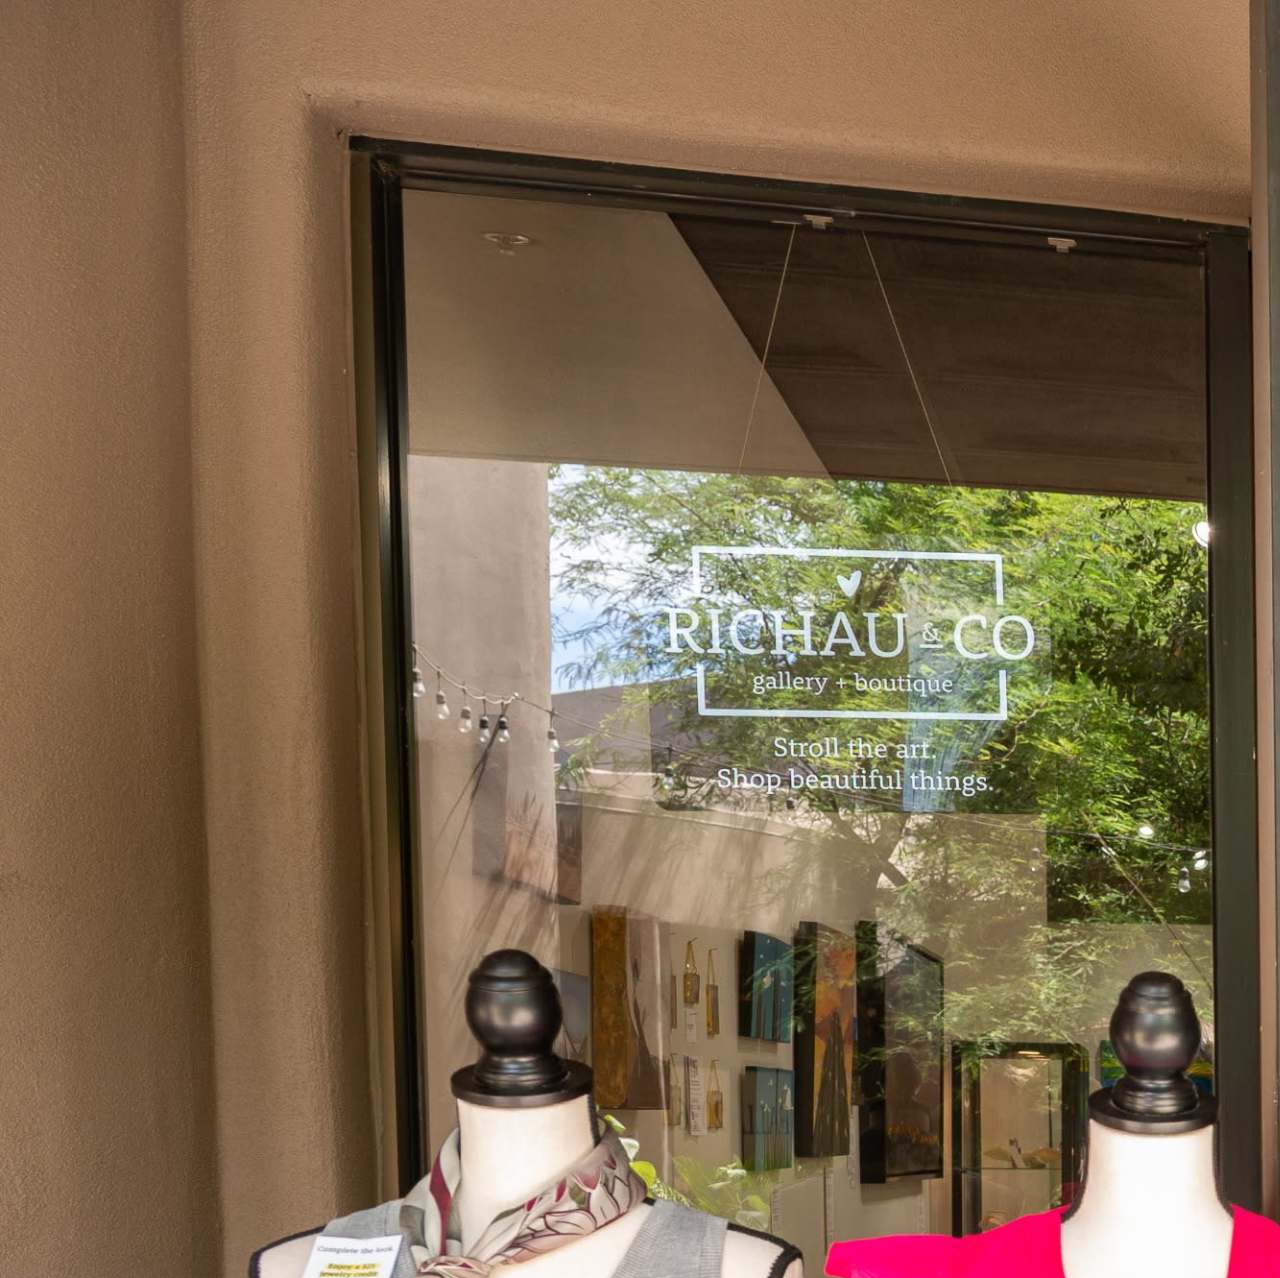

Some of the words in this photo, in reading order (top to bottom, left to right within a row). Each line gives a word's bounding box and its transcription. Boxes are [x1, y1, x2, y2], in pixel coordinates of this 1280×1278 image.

[664, 606, 908, 658] RICHAU
[919, 622, 943, 648] &
[953, 613, 1035, 661] CO
[752, 672, 828, 695] gallery
[836, 678, 846, 688] +
[854, 673, 953, 693] boutique
[773, 737, 840, 759] Stroll
[848, 738, 887, 758] the
[896, 741, 937, 759] art.
[717, 768, 781, 791] Shop
[788, 769, 903, 791] beautiful
[910, 770, 994, 792] things.
